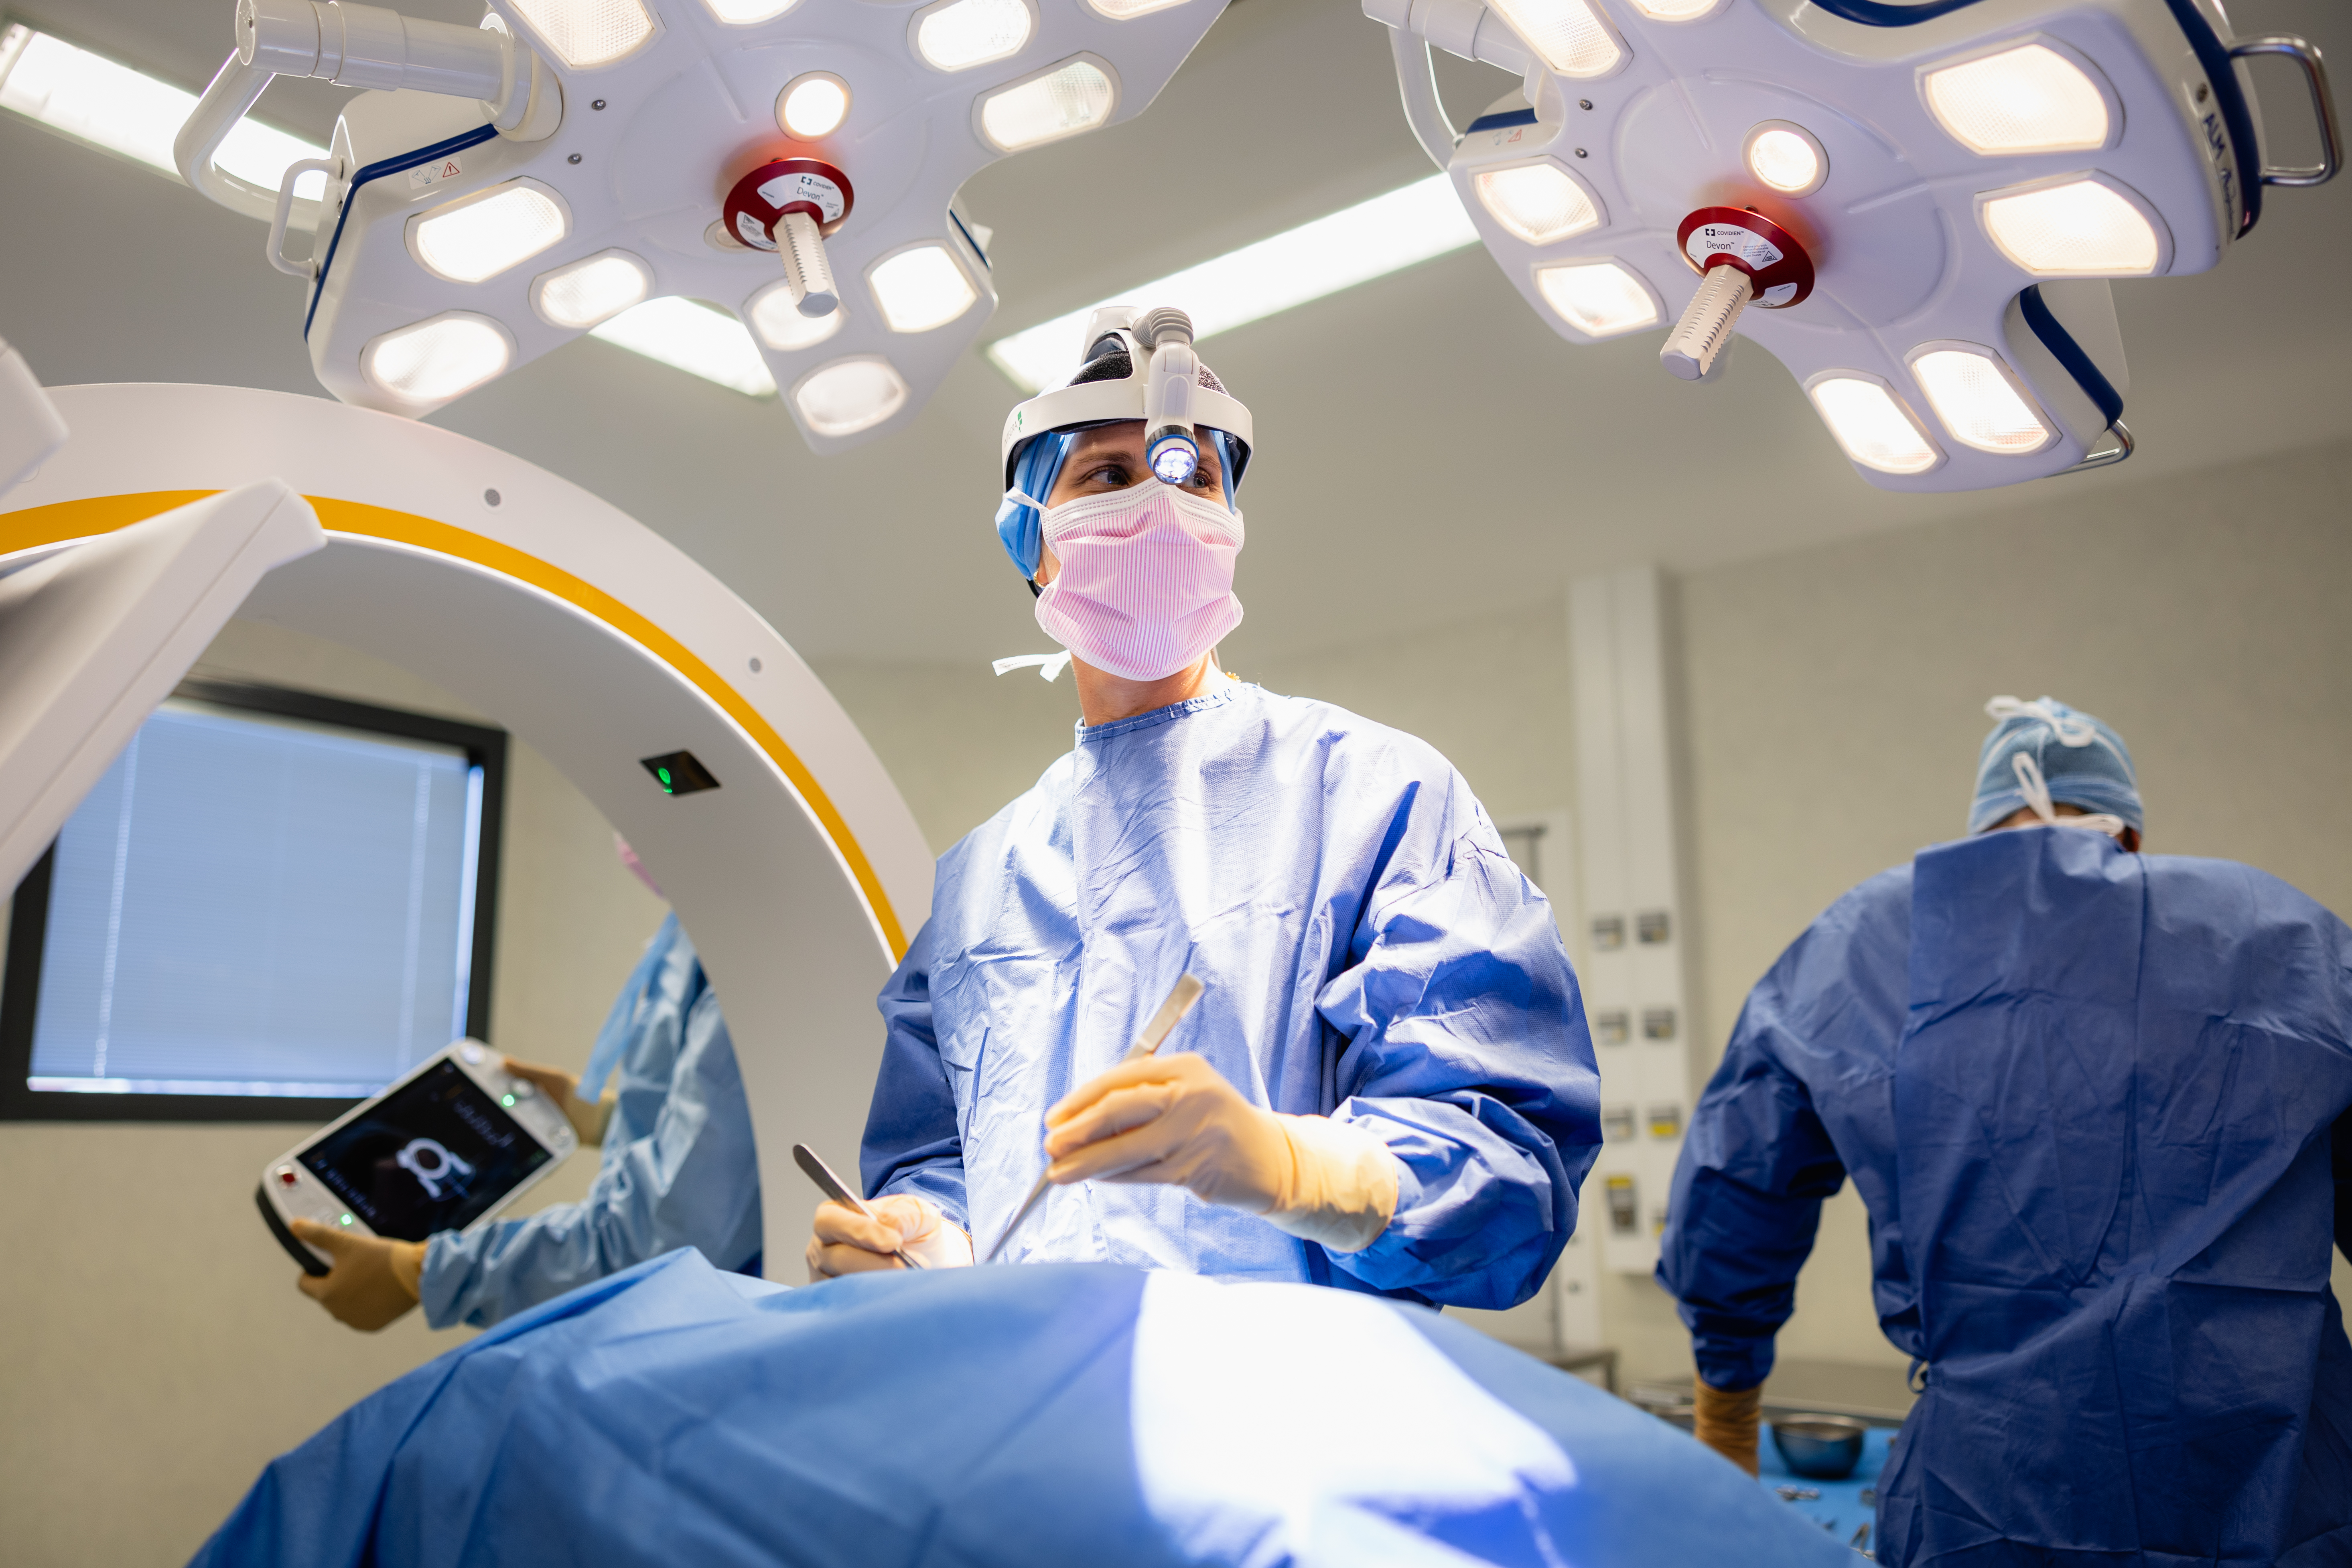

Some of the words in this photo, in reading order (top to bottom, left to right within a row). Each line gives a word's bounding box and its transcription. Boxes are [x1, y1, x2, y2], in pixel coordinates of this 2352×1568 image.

[2204, 113, 2225, 160] ALM
[1707, 240, 1735, 250] Devon™
[1004, 421, 1018, 448] INTEGRA
